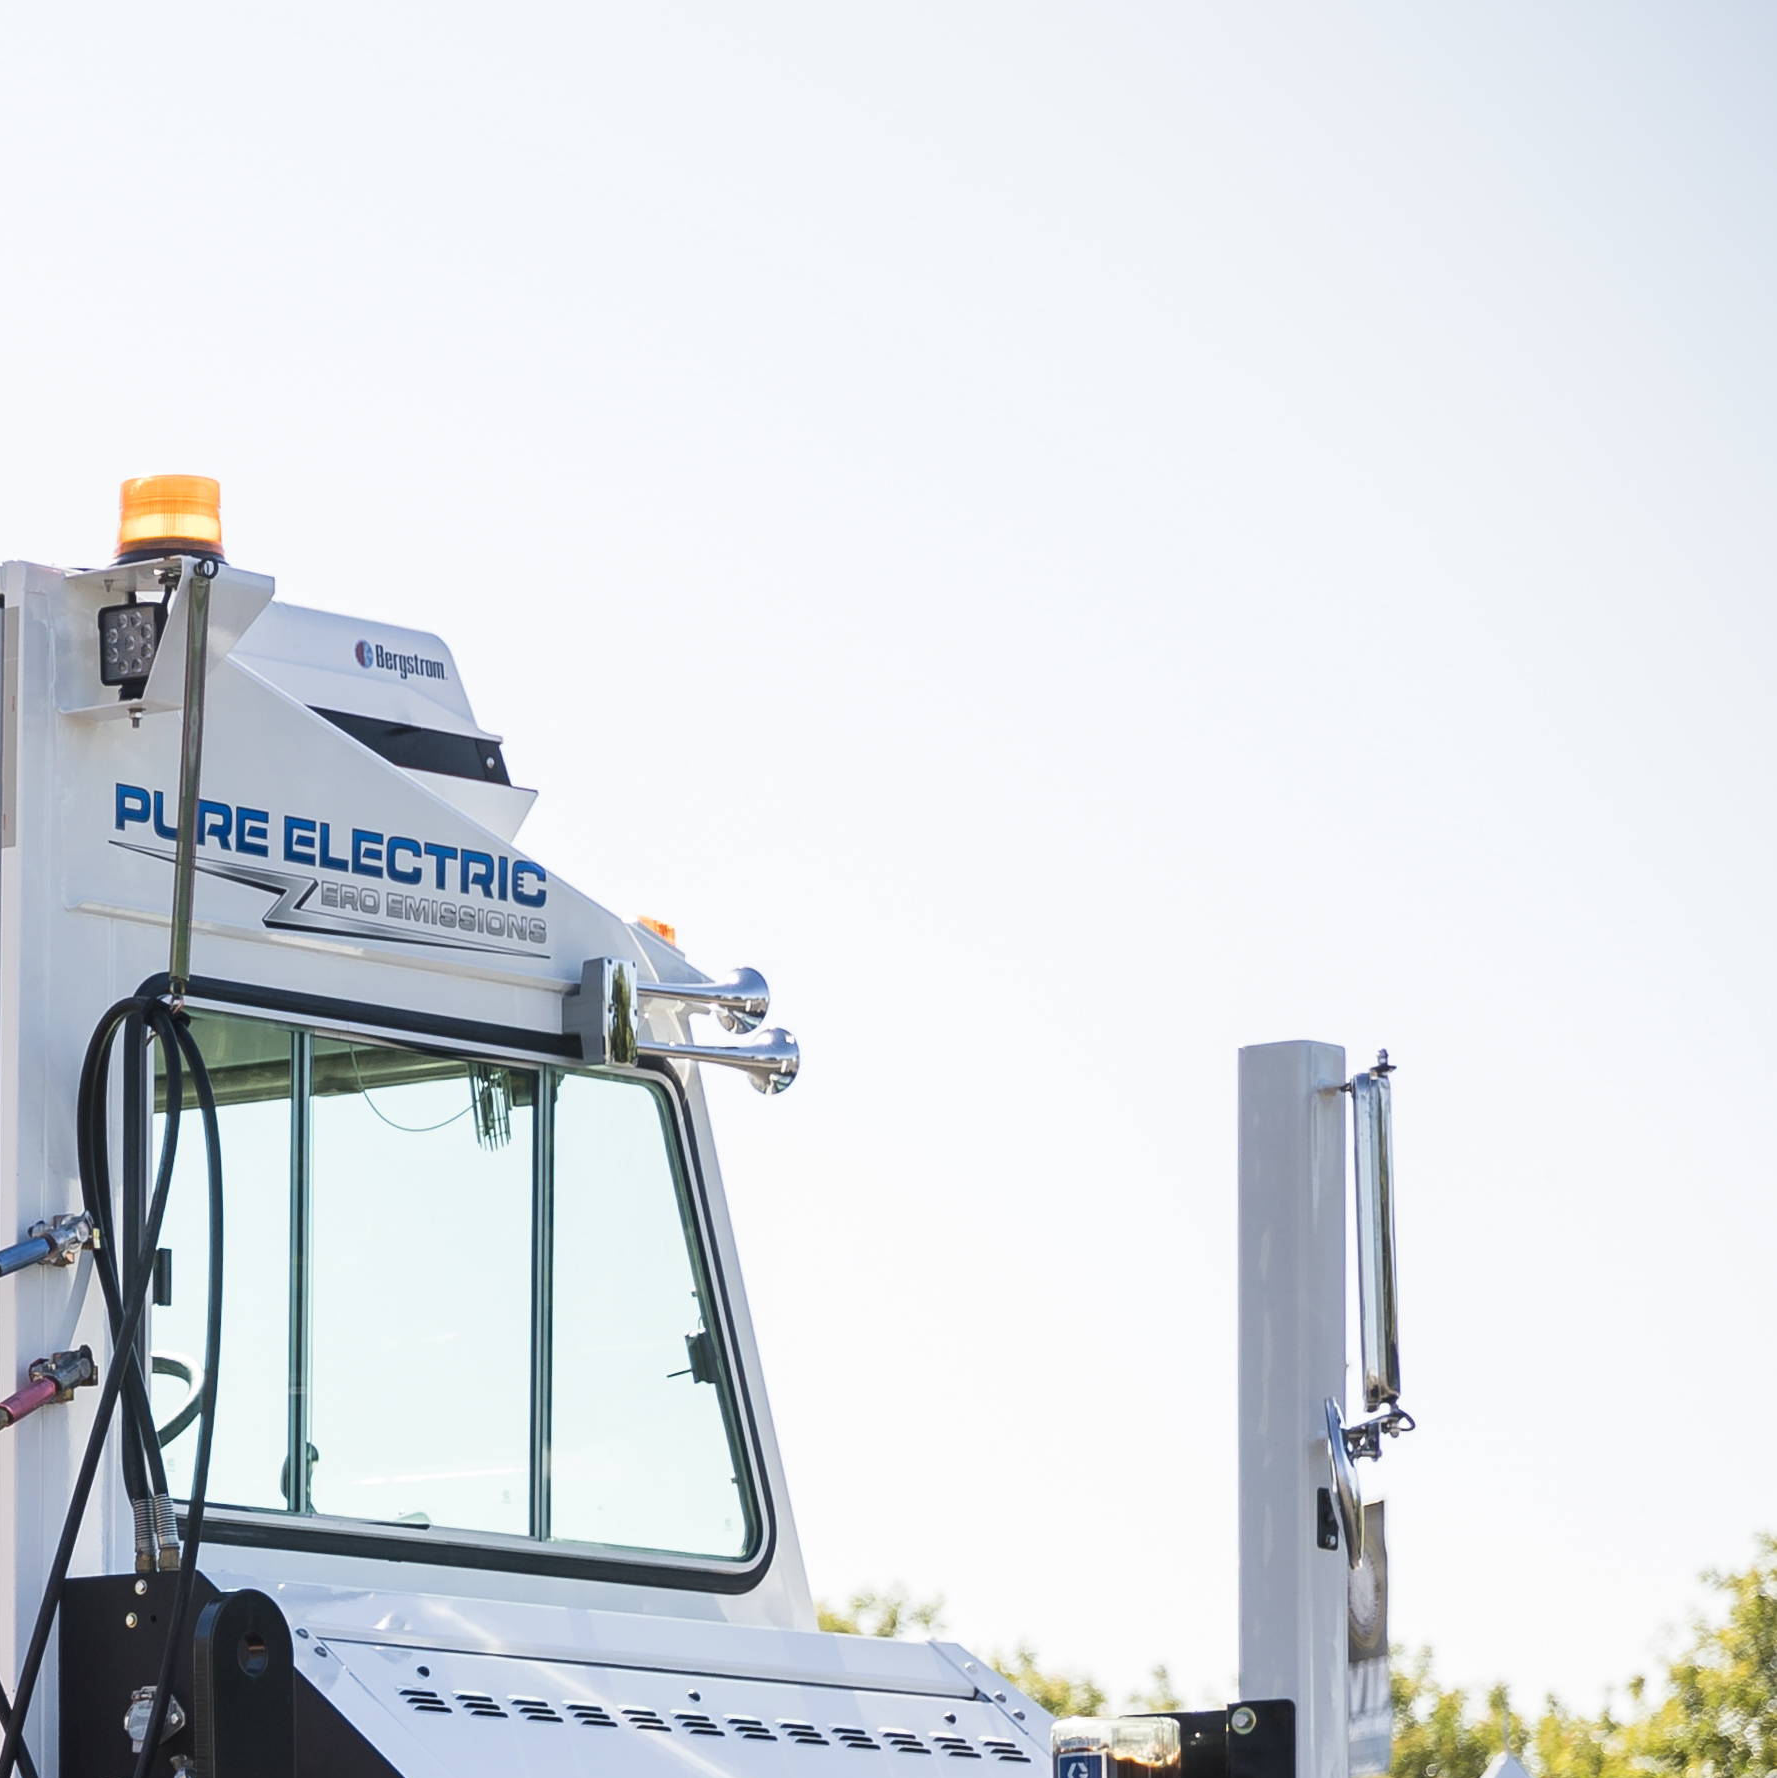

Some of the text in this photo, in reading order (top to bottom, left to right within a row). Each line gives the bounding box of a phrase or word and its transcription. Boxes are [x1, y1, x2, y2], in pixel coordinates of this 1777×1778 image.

[375, 644, 445, 680] Bergstrom
[115, 782, 547, 909] PURE ELECTRIC
[386, 894, 547, 944] EMISSIONS
